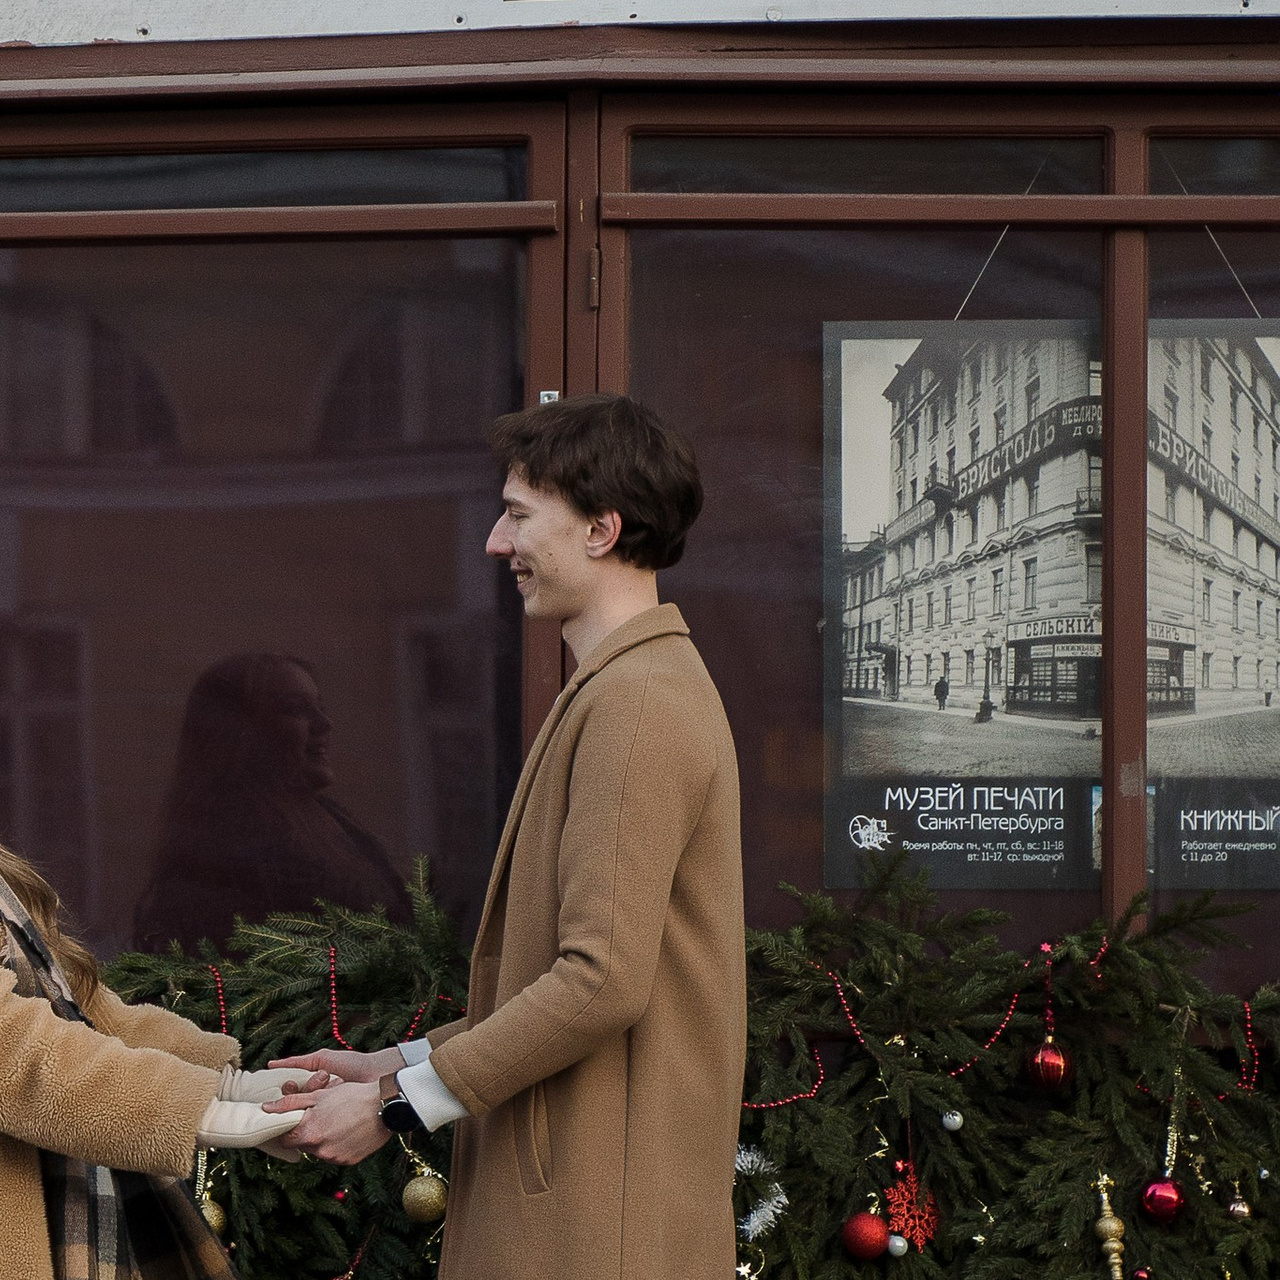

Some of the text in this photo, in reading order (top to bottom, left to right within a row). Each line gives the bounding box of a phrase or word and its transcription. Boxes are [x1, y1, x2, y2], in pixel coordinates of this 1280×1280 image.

[885, 783, 1064, 811] МУЗЕЙ ПЕЧАТИ
[917, 814, 1064, 833] Санкт-Петербурга
[1181, 840, 1277, 851] Работает ежедневно
[1022, 851, 1065, 862] выходной
[1181, 851, 1228, 862] с 11 до 20
